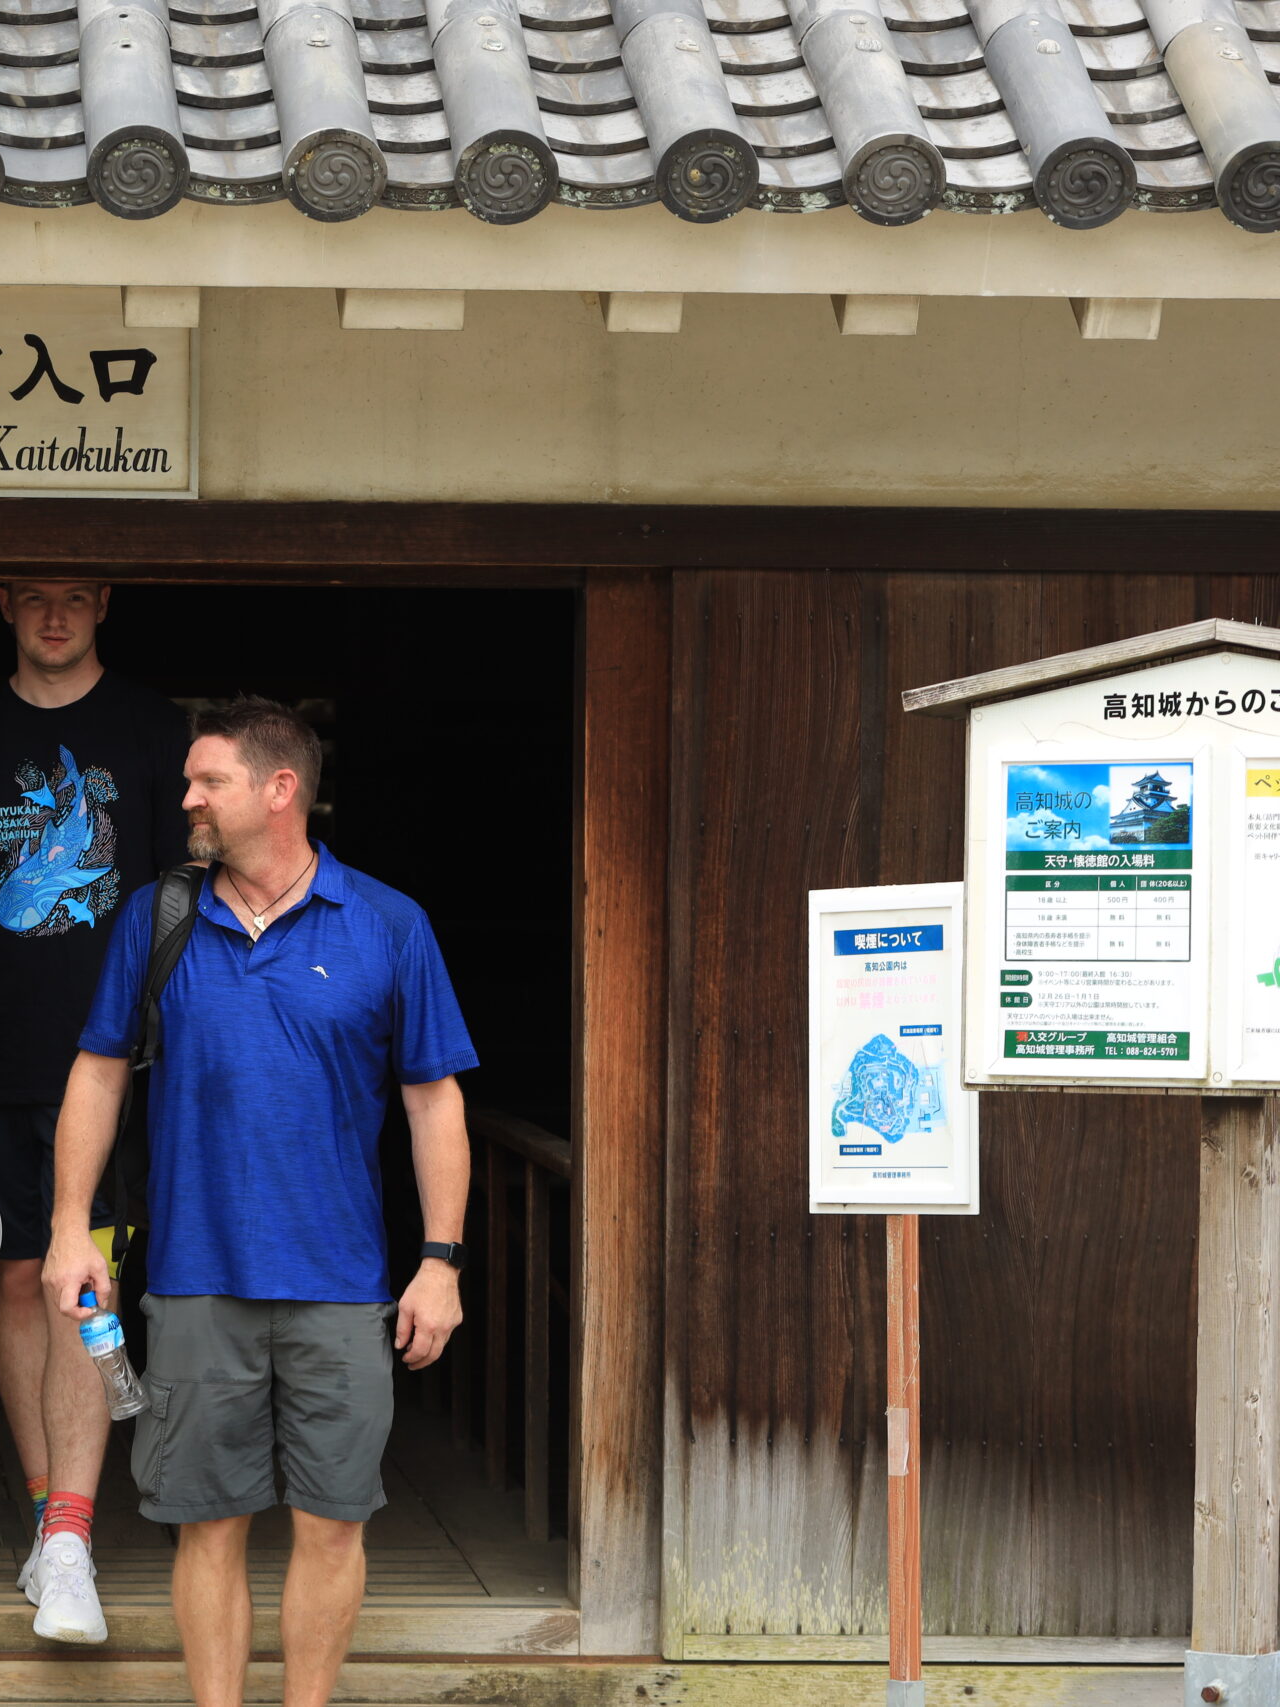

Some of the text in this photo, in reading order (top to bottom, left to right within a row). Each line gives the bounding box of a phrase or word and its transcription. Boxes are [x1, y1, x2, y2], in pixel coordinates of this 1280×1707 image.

[1015, 791, 1092, 811] 高知城の
[1025, 819, 1081, 840] ご案内
[1044, 854, 1155, 868] 天守・懐徳館の入場料
[1107, 896, 1128, 904] 500円
[1153, 896, 1175, 904] 400円
[854, 931, 923, 950] 喫煙について
[864, 961, 907, 972] 高知公園内は
[1106, 1033, 1177, 1044] 高知城管理組合
[1015, 1045, 1095, 1055] 高知城管理事務所
